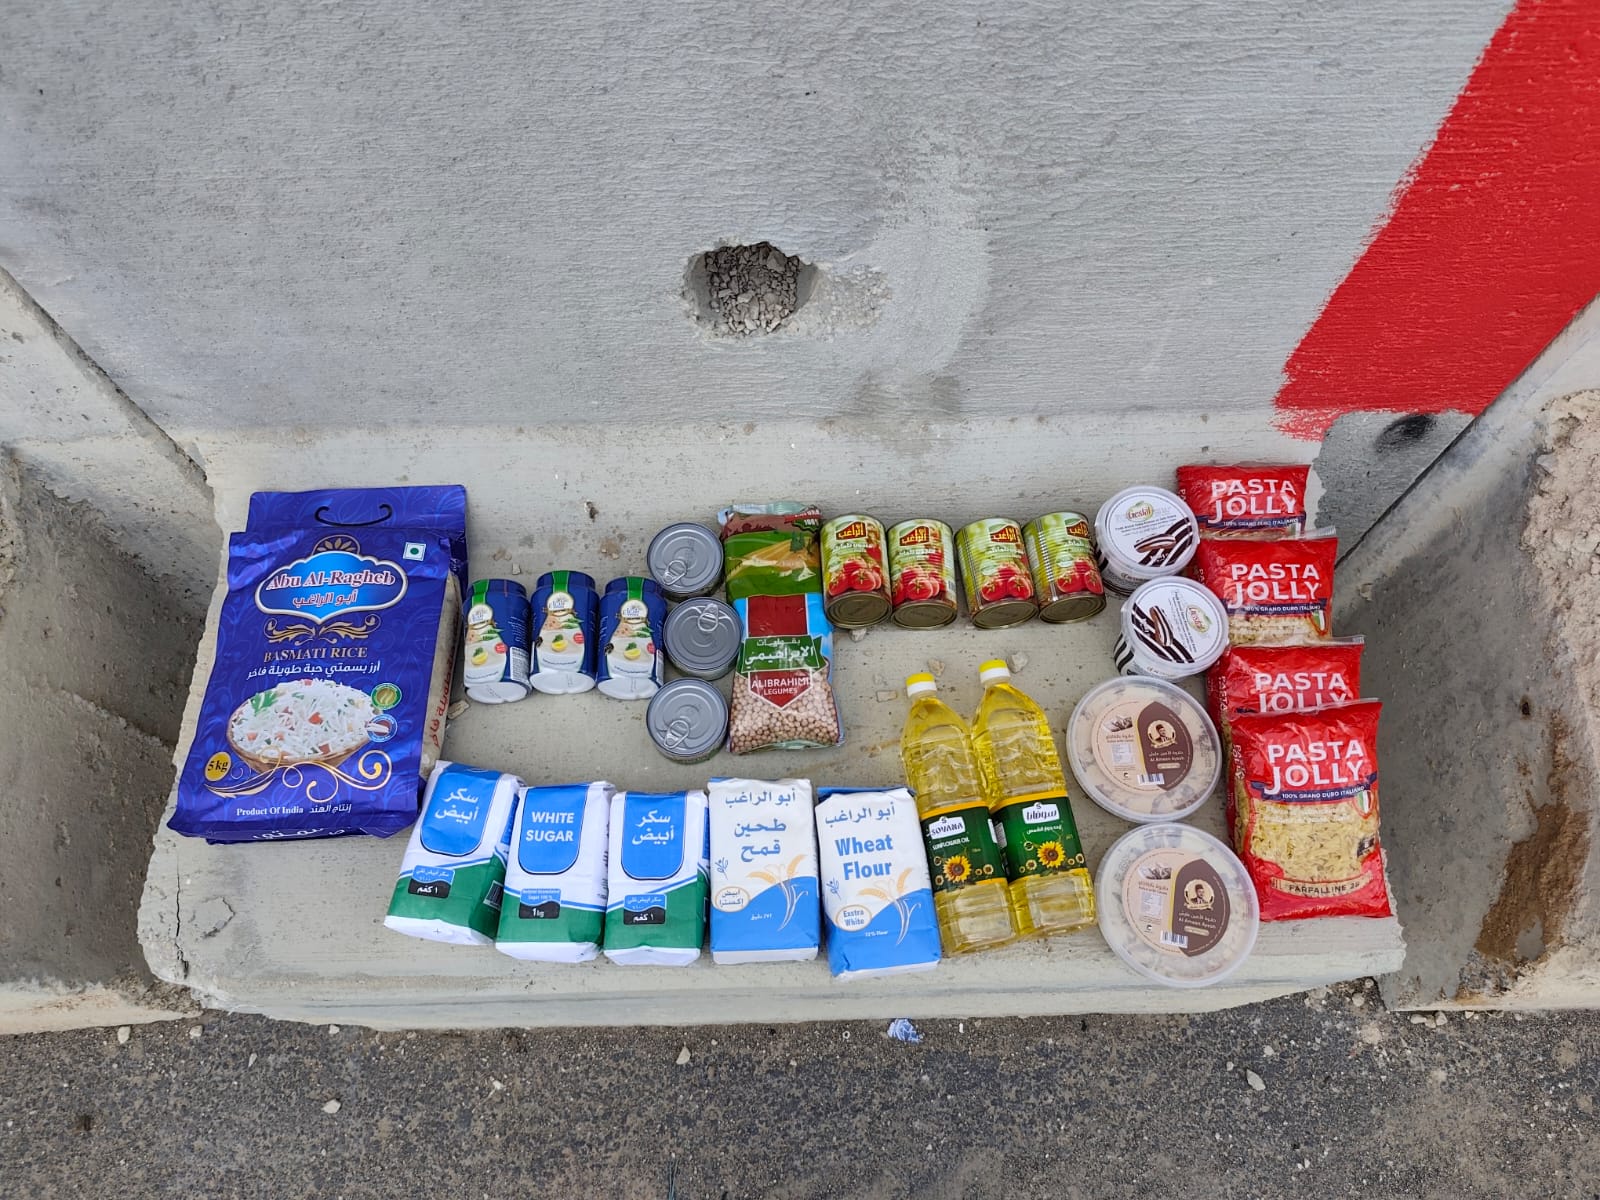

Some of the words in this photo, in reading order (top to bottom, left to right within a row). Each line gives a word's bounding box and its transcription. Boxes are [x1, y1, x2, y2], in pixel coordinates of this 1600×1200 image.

[1211, 478, 1297, 497] PASTA
[1208, 495, 1297, 524] JOLLY
[266, 573, 300, 590] Abu
[304, 570, 396, 587] Al-Ragheb
[1231, 563, 1320, 581] PASTA
[1228, 580, 1321, 609] JOLLY
[264, 647, 327, 662] BASMATI
[330, 647, 368, 659] RICE
[268, 663, 302, 677] طويلة
[303, 663, 323, 677] حبة
[325, 663, 367, 677] بسمتي
[1255, 672, 1347, 691] PASTA
[763, 687, 798, 696] LEGUMES
[1267, 739, 1364, 764] PASTA
[207, 762, 216, 771] 5
[215, 759, 228, 773] kg
[1263, 759, 1364, 795] JOLLY
[444, 788, 479, 803] سكر
[725, 790, 772, 808] الراغب
[775, 788, 796, 806] أبو
[1340, 785, 1365, 797] ITALIANO
[236, 807, 267, 816] Product
[269, 806, 281, 815] Of
[282, 806, 304, 815] India
[434, 806, 479, 824] أبيض
[531, 811, 575, 824] WHITE
[635, 810, 671, 827] سكر
[825, 807, 872, 828] الراغب
[877, 802, 896, 821] أبو
[525, 829, 574, 842] SUGAR
[631, 826, 675, 845] أبيض
[734, 818, 787, 837] طحين
[740, 839, 781, 862] قمح
[835, 834, 893, 856] Wheat
[843, 862, 892, 880] Flour
[845, 918, 865, 927] White
